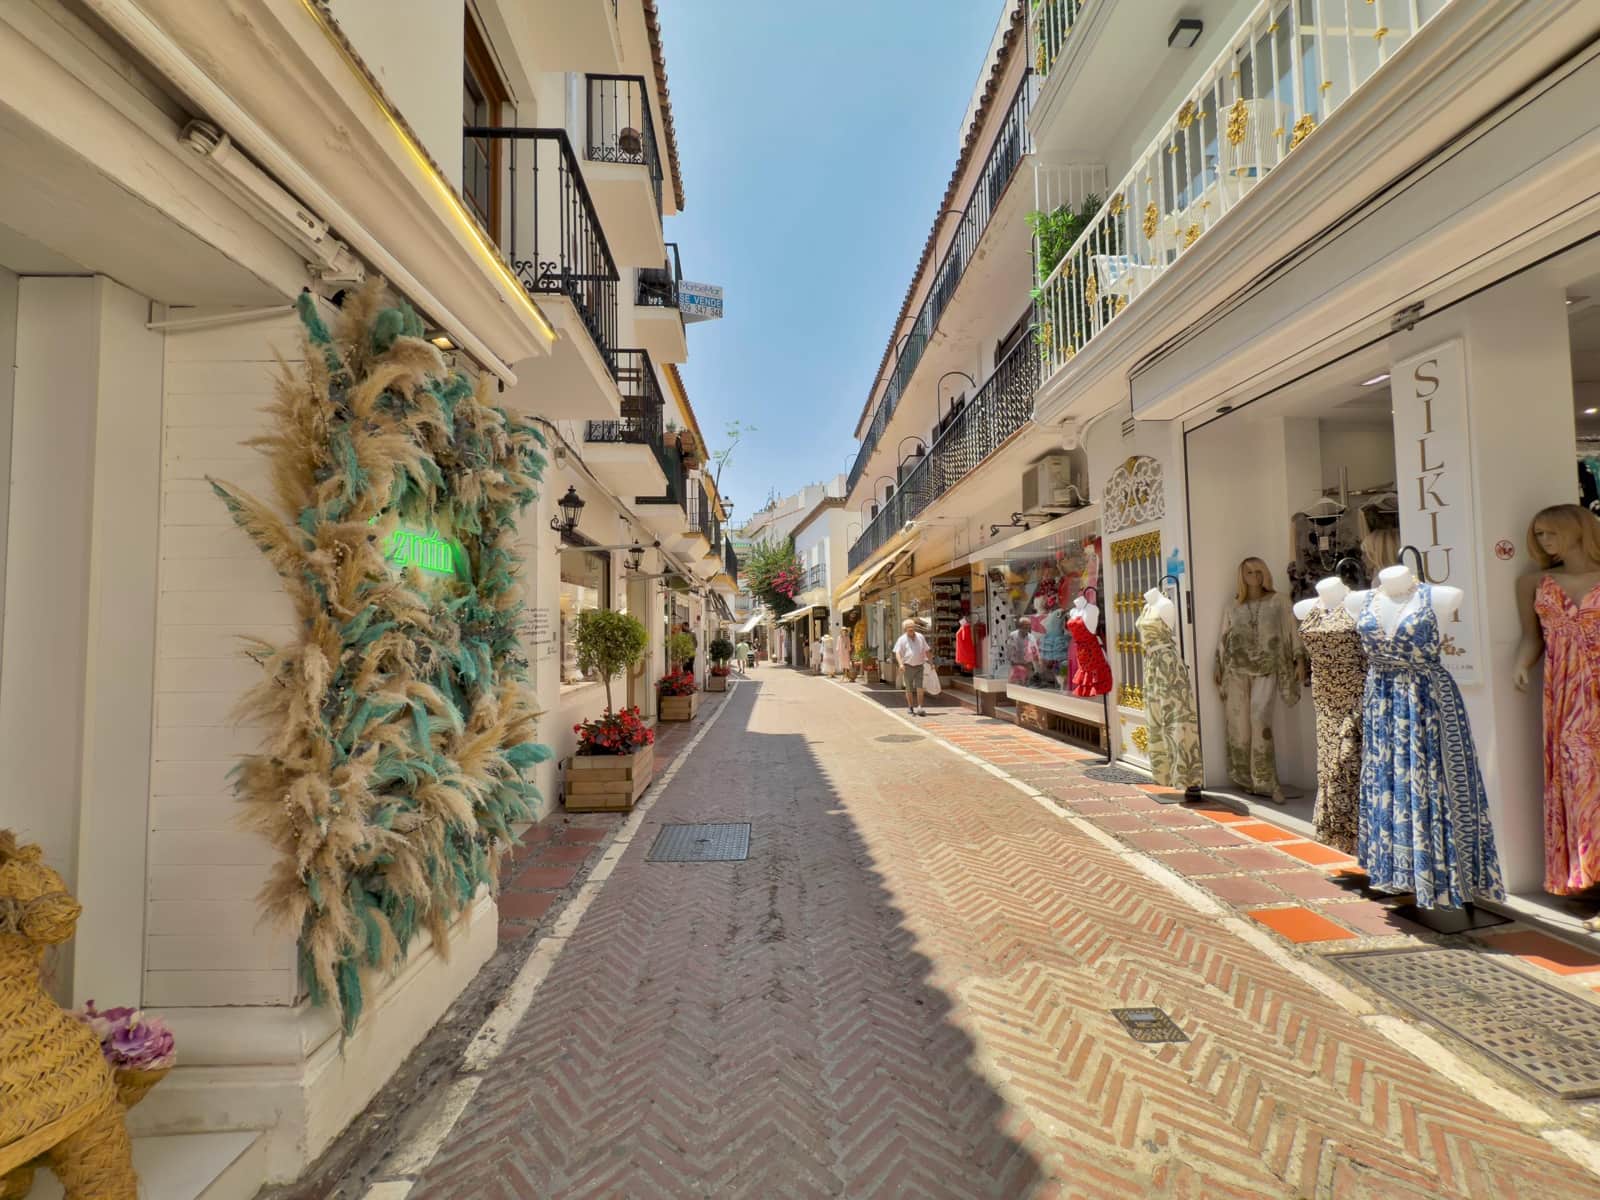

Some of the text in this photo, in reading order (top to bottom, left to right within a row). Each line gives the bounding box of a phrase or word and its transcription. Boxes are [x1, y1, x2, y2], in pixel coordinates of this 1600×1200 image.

[679, 294, 690, 304] SE
[694, 296, 721, 308] VENDE
[1413, 358, 1461, 622] SILKIU
